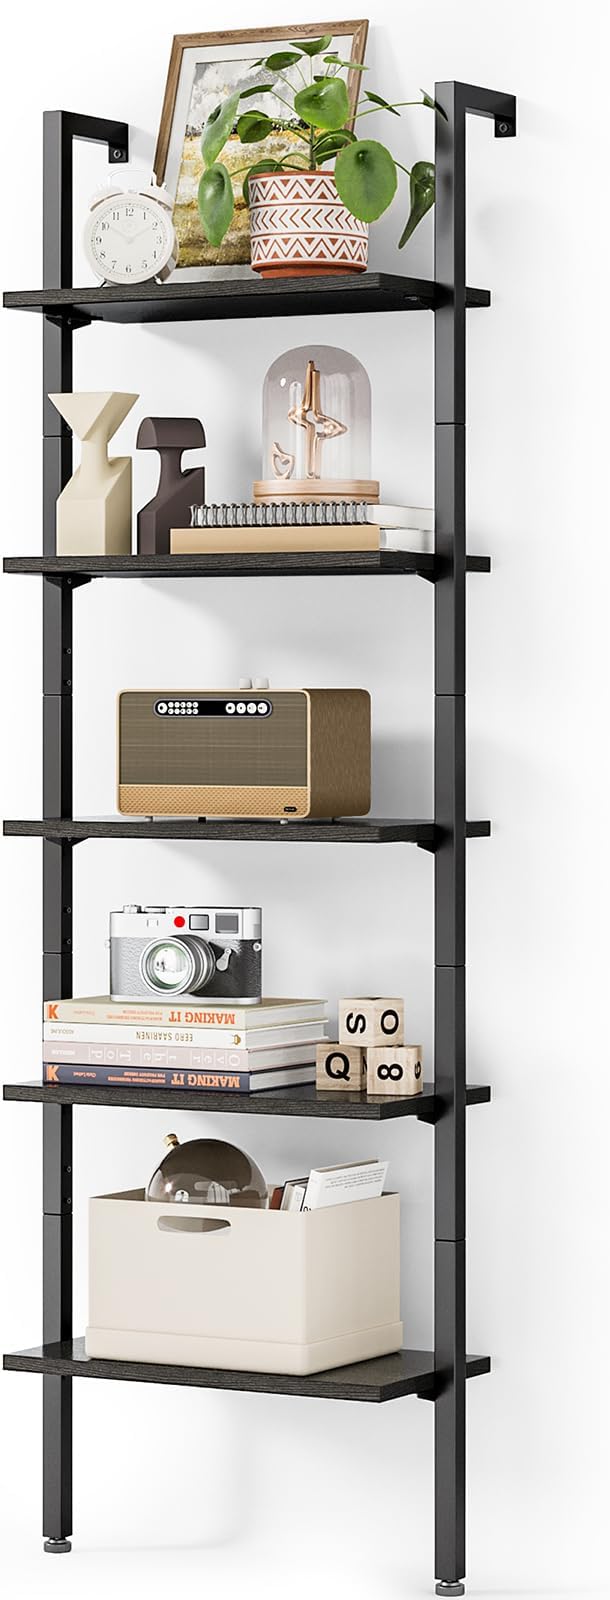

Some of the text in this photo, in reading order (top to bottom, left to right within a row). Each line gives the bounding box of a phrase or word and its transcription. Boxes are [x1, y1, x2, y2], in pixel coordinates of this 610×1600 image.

[112, 212, 120, 220] 11
[126, 208, 134, 216] 12
[102, 222, 110, 230] 10
[152, 222, 158, 230] 2
[96, 236, 102, 245] 9
[156, 236, 162, 244] 3
[100, 251, 106, 259] 8
[112, 260, 118, 270] 7
[141, 260, 148, 269] 5
[168, 1011, 181, 1022] IT
[185, 1012, 235, 1024] MAKING
[346, 1012, 366, 1034] S
[136, 1031, 193, 1042] EERO SAARINEN
[325, 1052, 350, 1081] Q
[377, 1063, 404, 1081] 8
[171, 1073, 184, 1085] IT
[188, 1074, 240, 1088] MAKING
